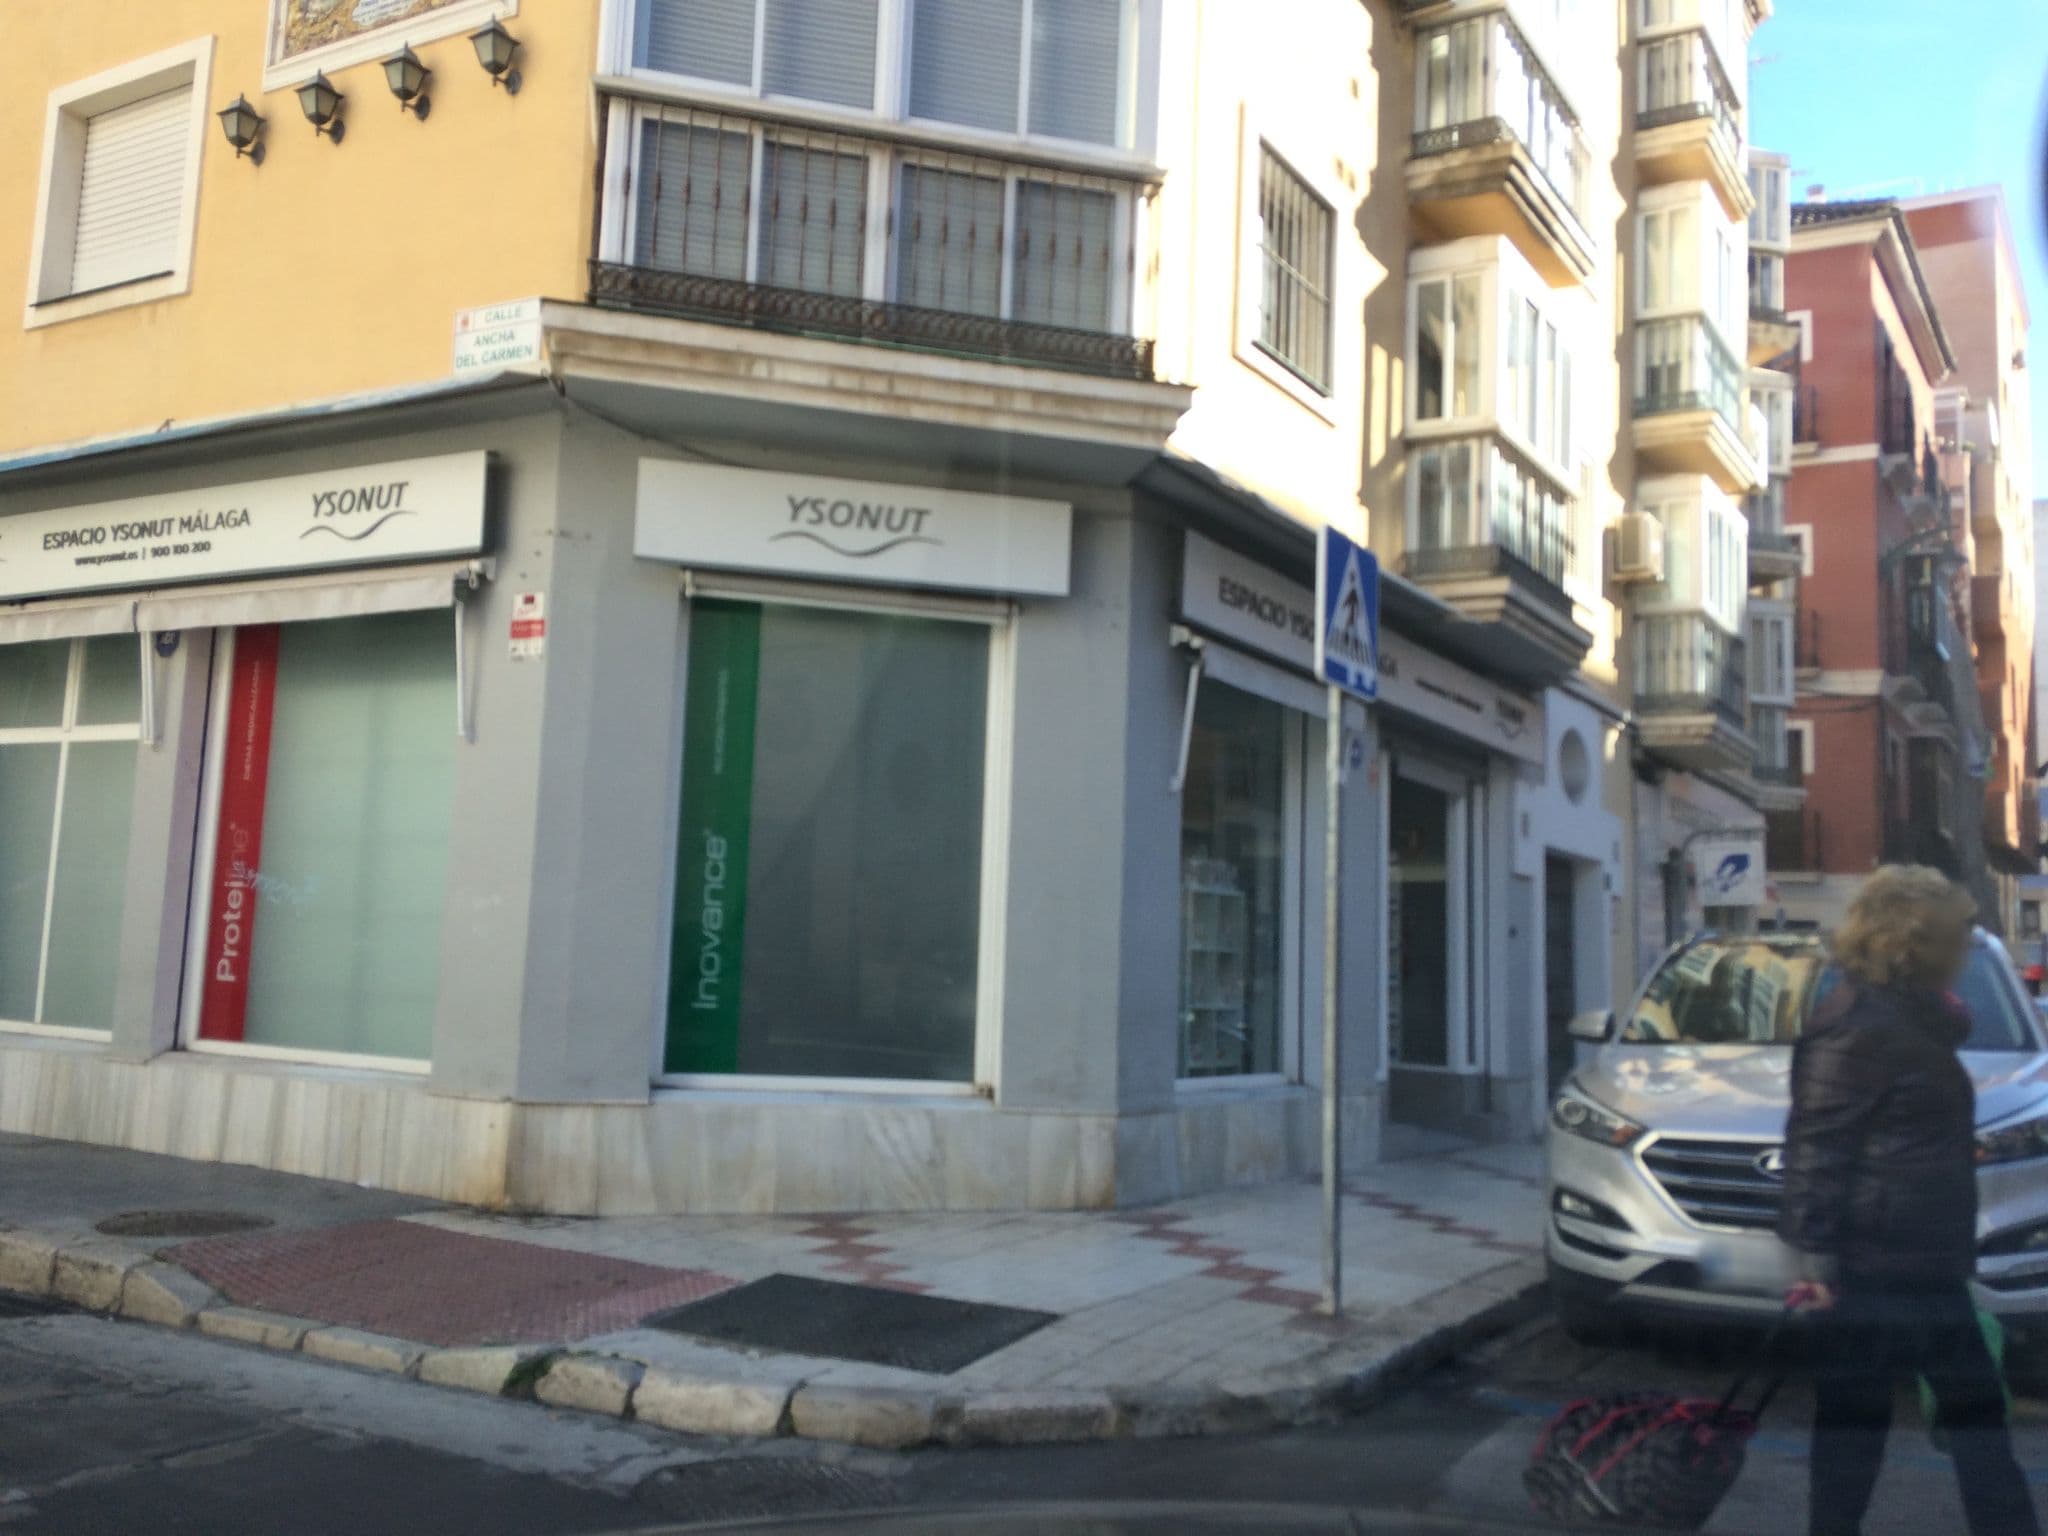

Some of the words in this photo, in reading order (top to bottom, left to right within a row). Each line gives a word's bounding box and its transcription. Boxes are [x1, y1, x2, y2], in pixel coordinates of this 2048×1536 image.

[484, 305, 521, 323] CALLE
[455, 353, 478, 369] DEL
[481, 344, 533, 363] CARMEN
[474, 329, 515, 347] ANCHA
[312, 481, 409, 518] YSONUT
[787, 494, 932, 534] YSONUT
[43, 527, 106, 551] ESPACIO
[111, 517, 175, 542] YSONUT
[179, 508, 250, 534] MÁLAGA
[1218, 576, 1287, 630] ESPACIO
[691, 836, 727, 1008] Inovance
